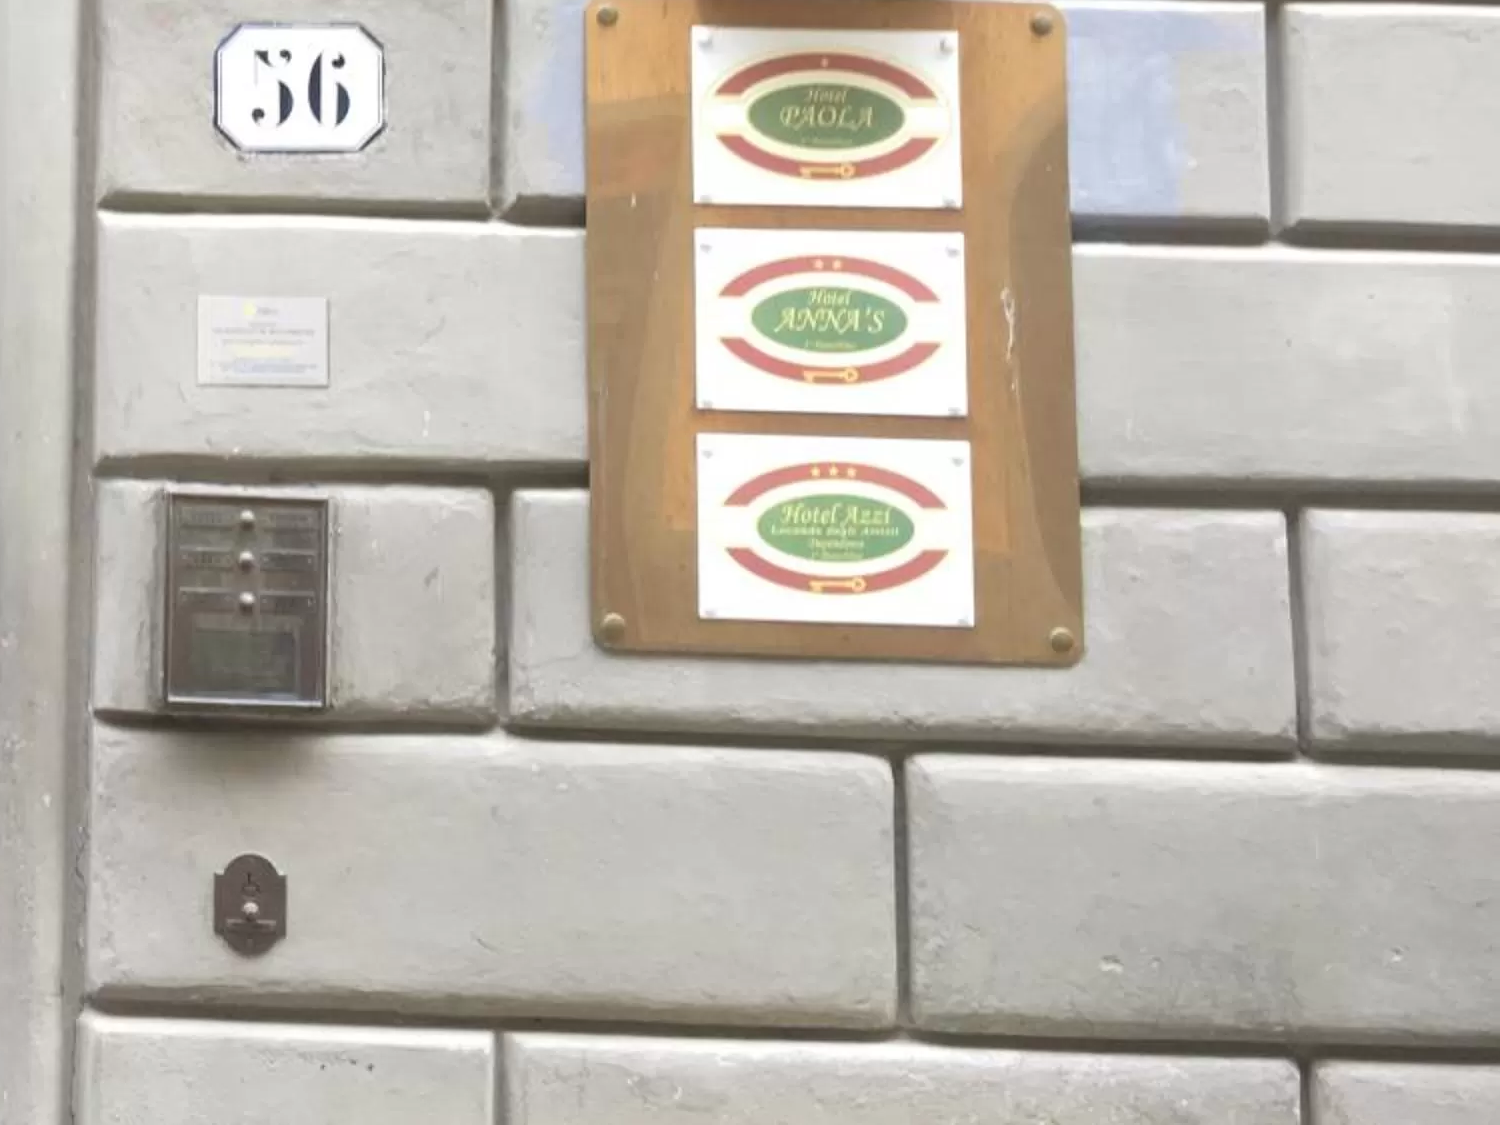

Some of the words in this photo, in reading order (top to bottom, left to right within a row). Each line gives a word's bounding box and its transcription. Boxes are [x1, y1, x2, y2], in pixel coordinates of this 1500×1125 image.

[251, 47, 351, 128] 56
[779, 104, 873, 130] PAOLA
[807, 289, 852, 306] Hotel
[774, 306, 885, 335] ANNA'S
[780, 503, 841, 525] Hotel
[842, 505, 892, 525] Azzi
